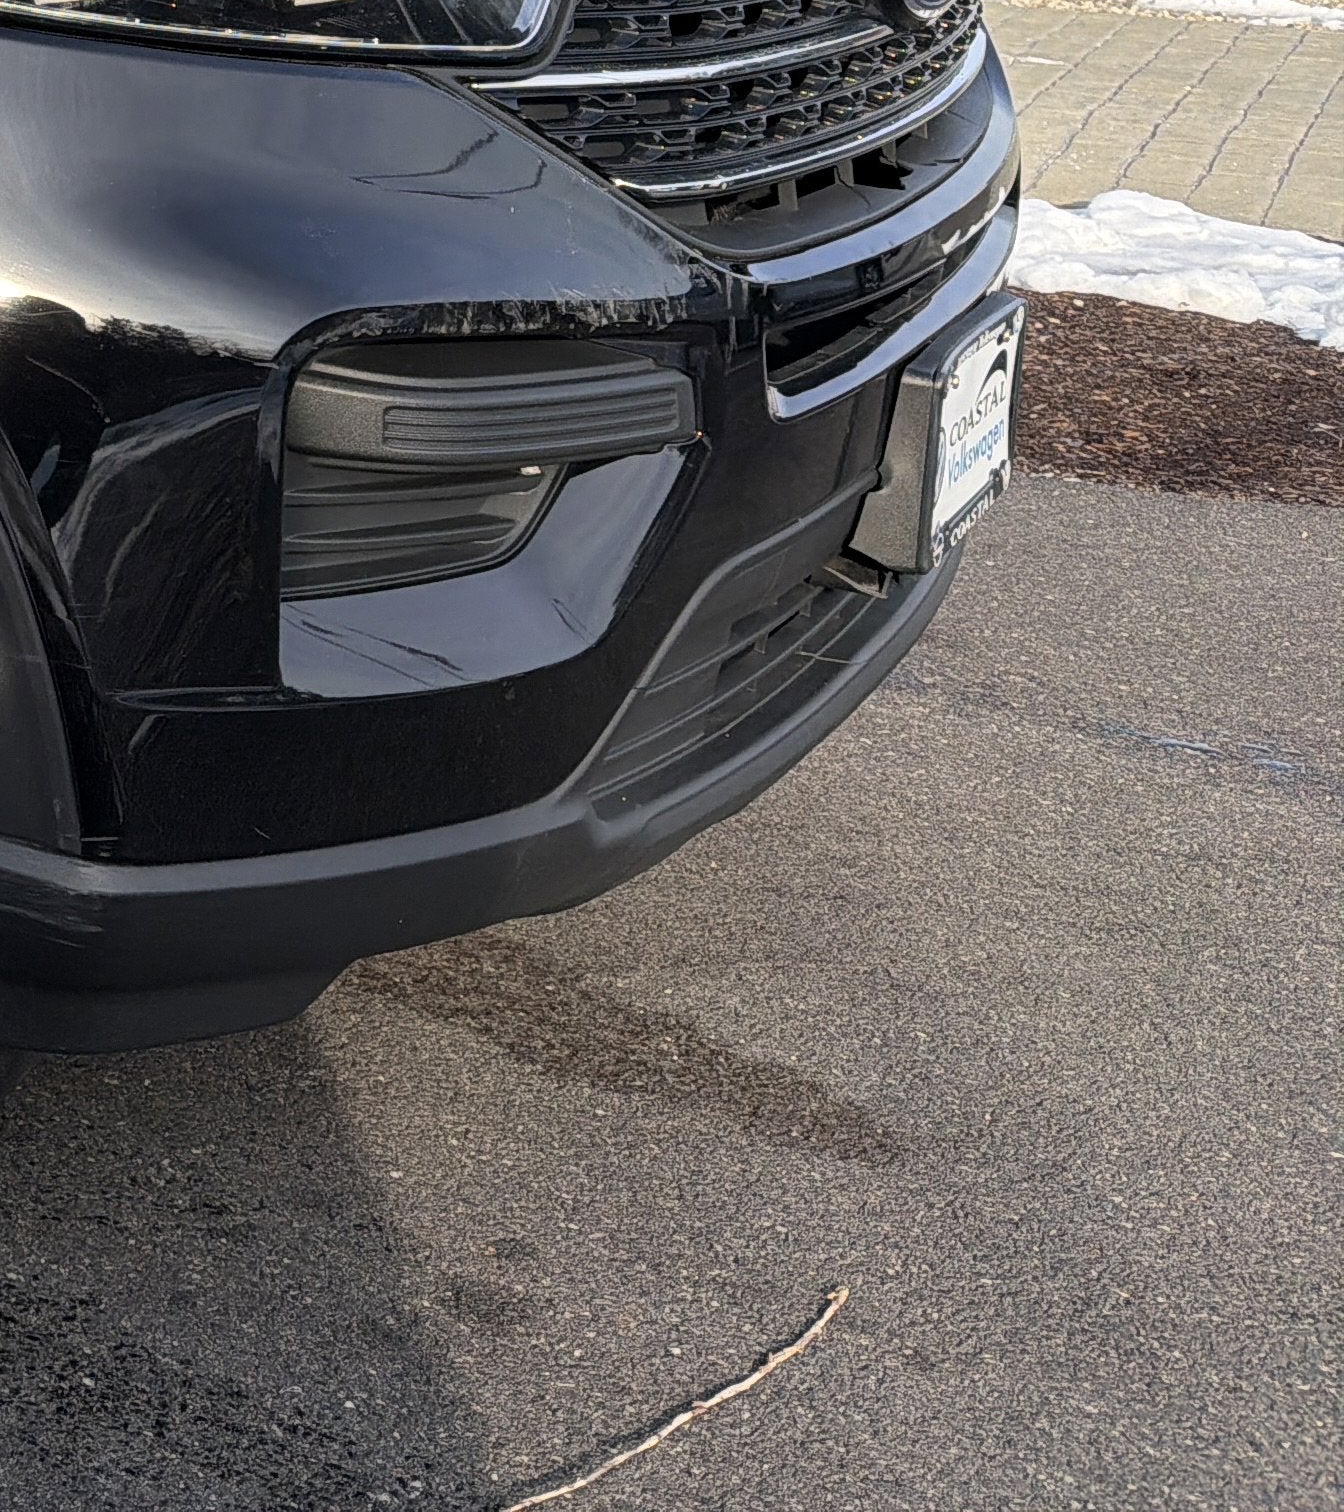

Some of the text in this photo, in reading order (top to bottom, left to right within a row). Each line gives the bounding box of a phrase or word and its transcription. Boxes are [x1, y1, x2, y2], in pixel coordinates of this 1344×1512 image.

[949, 380, 1007, 448] COASTAL
[947, 417, 1005, 487] Volkswagen
[950, 488, 996, 547] COASTAL
